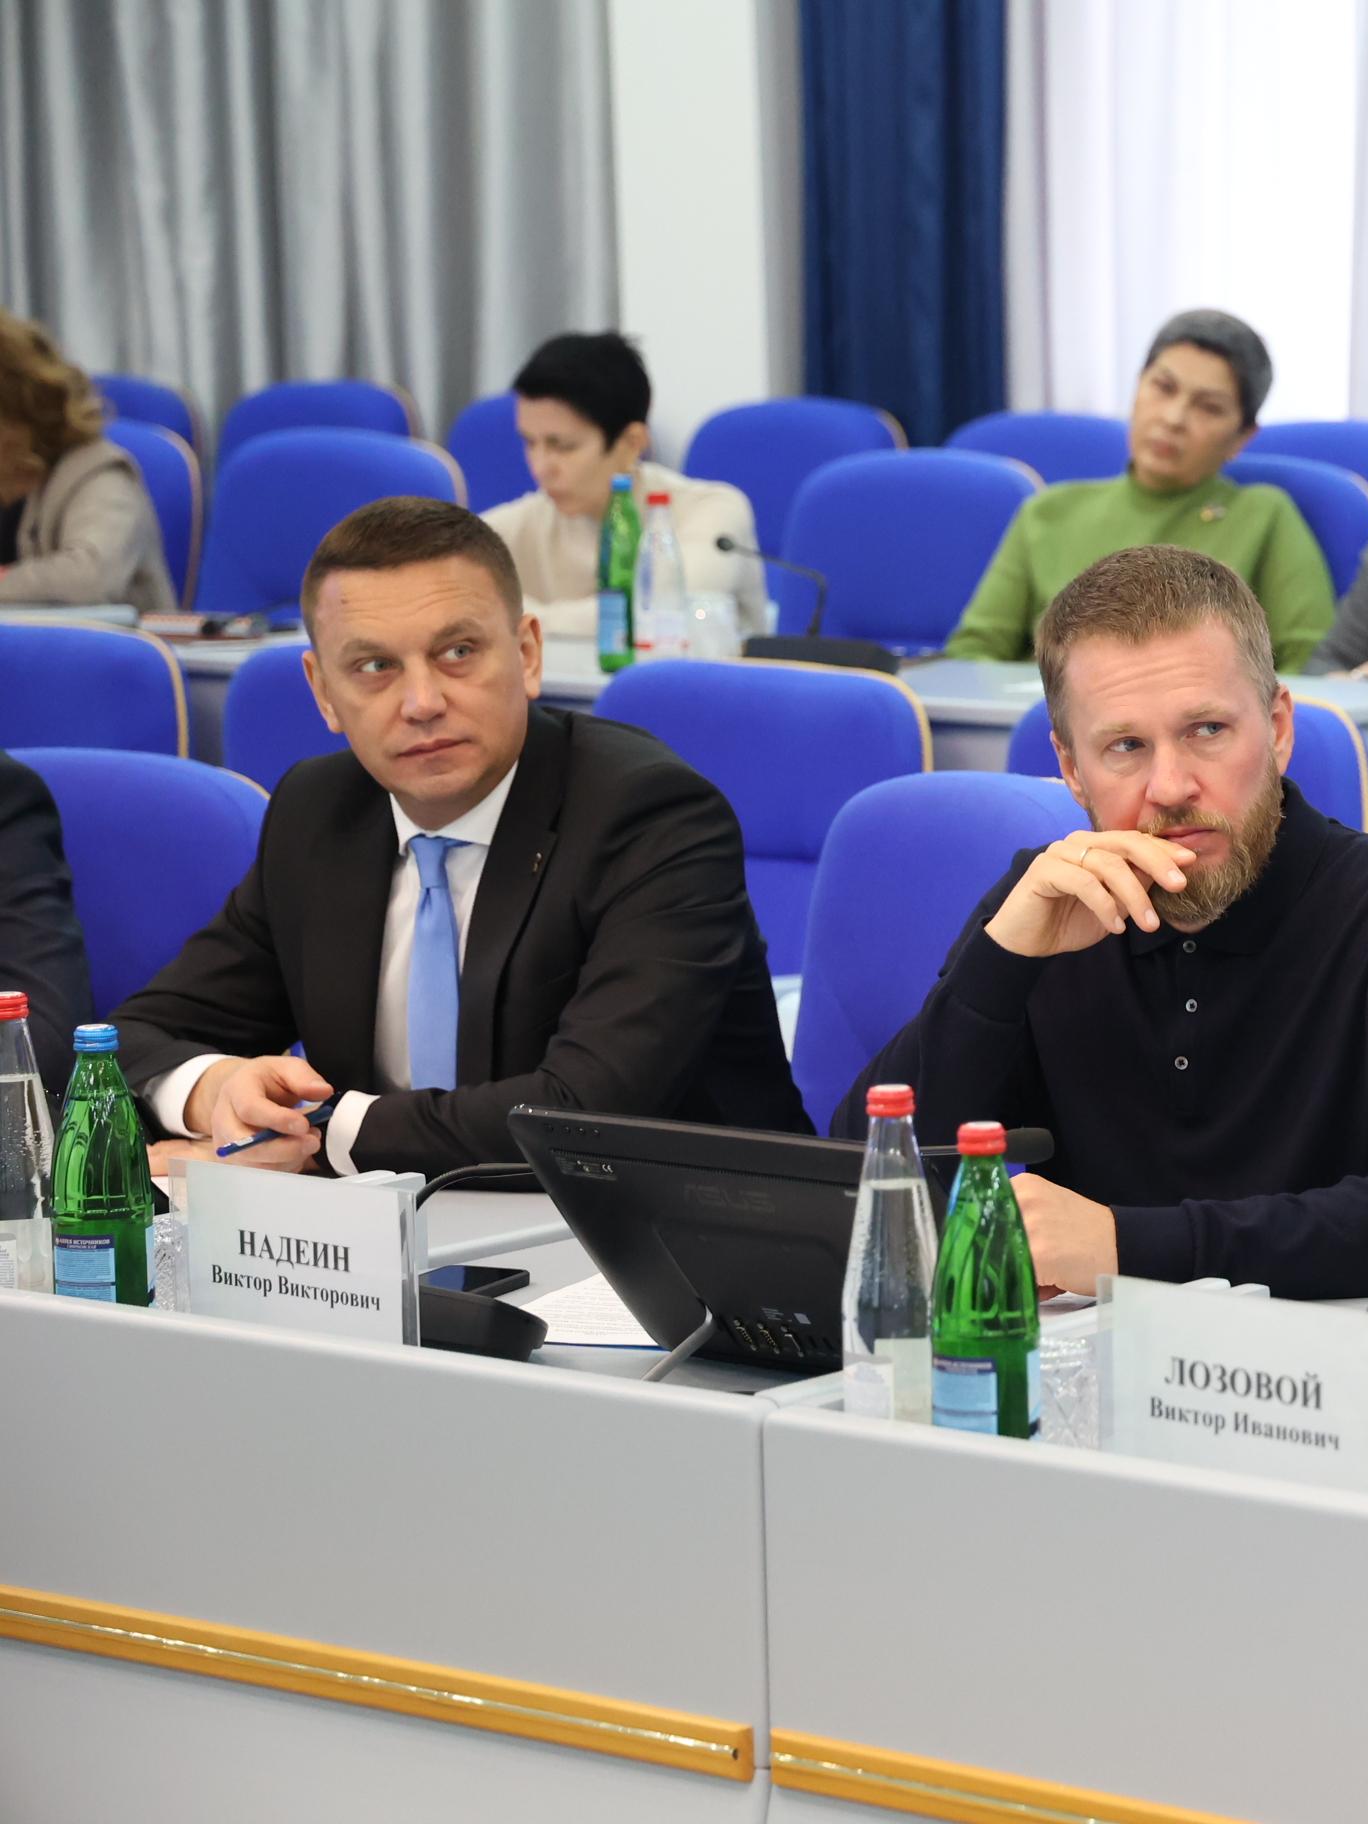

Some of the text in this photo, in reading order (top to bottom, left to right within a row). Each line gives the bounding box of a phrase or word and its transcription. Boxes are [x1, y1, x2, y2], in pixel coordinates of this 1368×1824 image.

[237, 1228, 351, 1273] НАДЕИН
[211, 1264, 381, 1312] Виктор Викторович
[1164, 1355, 1323, 1411] ЛОЗОВОЙ
[1149, 1395, 1340, 1450] Виктор Иванович
